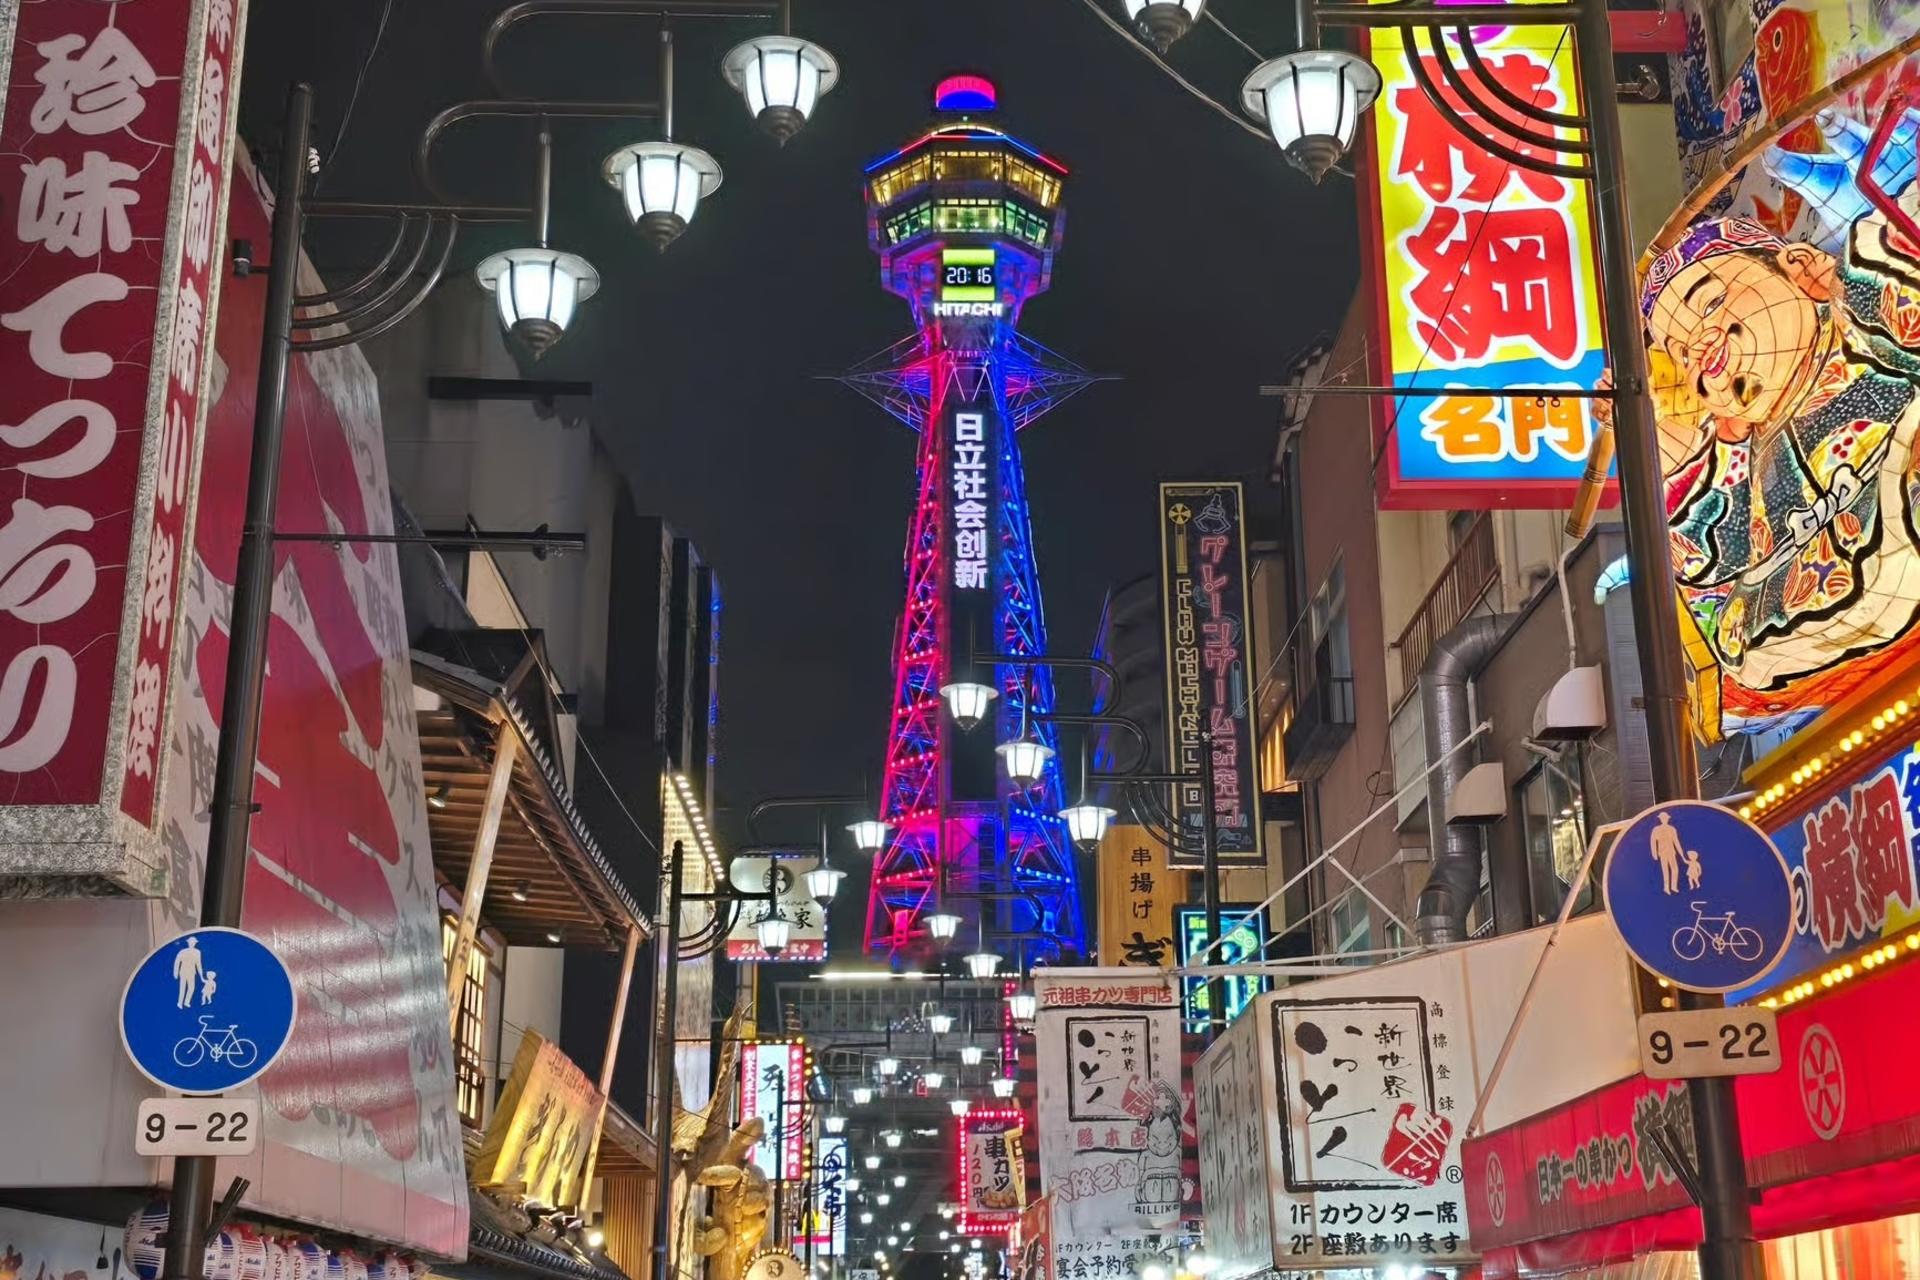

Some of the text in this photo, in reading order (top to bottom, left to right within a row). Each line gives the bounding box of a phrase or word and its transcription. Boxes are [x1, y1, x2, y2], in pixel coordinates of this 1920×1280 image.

[1393, 52, 1580, 365] 横綱
[933, 302, 1004, 317] HITACHI
[946, 266, 992, 284] 20:16
[1421, 385, 1589, 462] 名門
[1129, 846, 1155, 920] 串揚げ
[1805, 767, 1913, 952] 横綱
[1042, 985, 1173, 1006] 元祖串カツ専門店
[1373, 1021, 1413, 1099] 新世界
[1429, 1001, 1455, 1112] 商標登録
[984, 1135, 1010, 1192] 串カツ
[1537, 1132, 1634, 1206] 日本一の串かつ
[1290, 1231, 1461, 1255] 2F 座敷あります
[1291, 1201, 1458, 1225] 1F カウンター席
